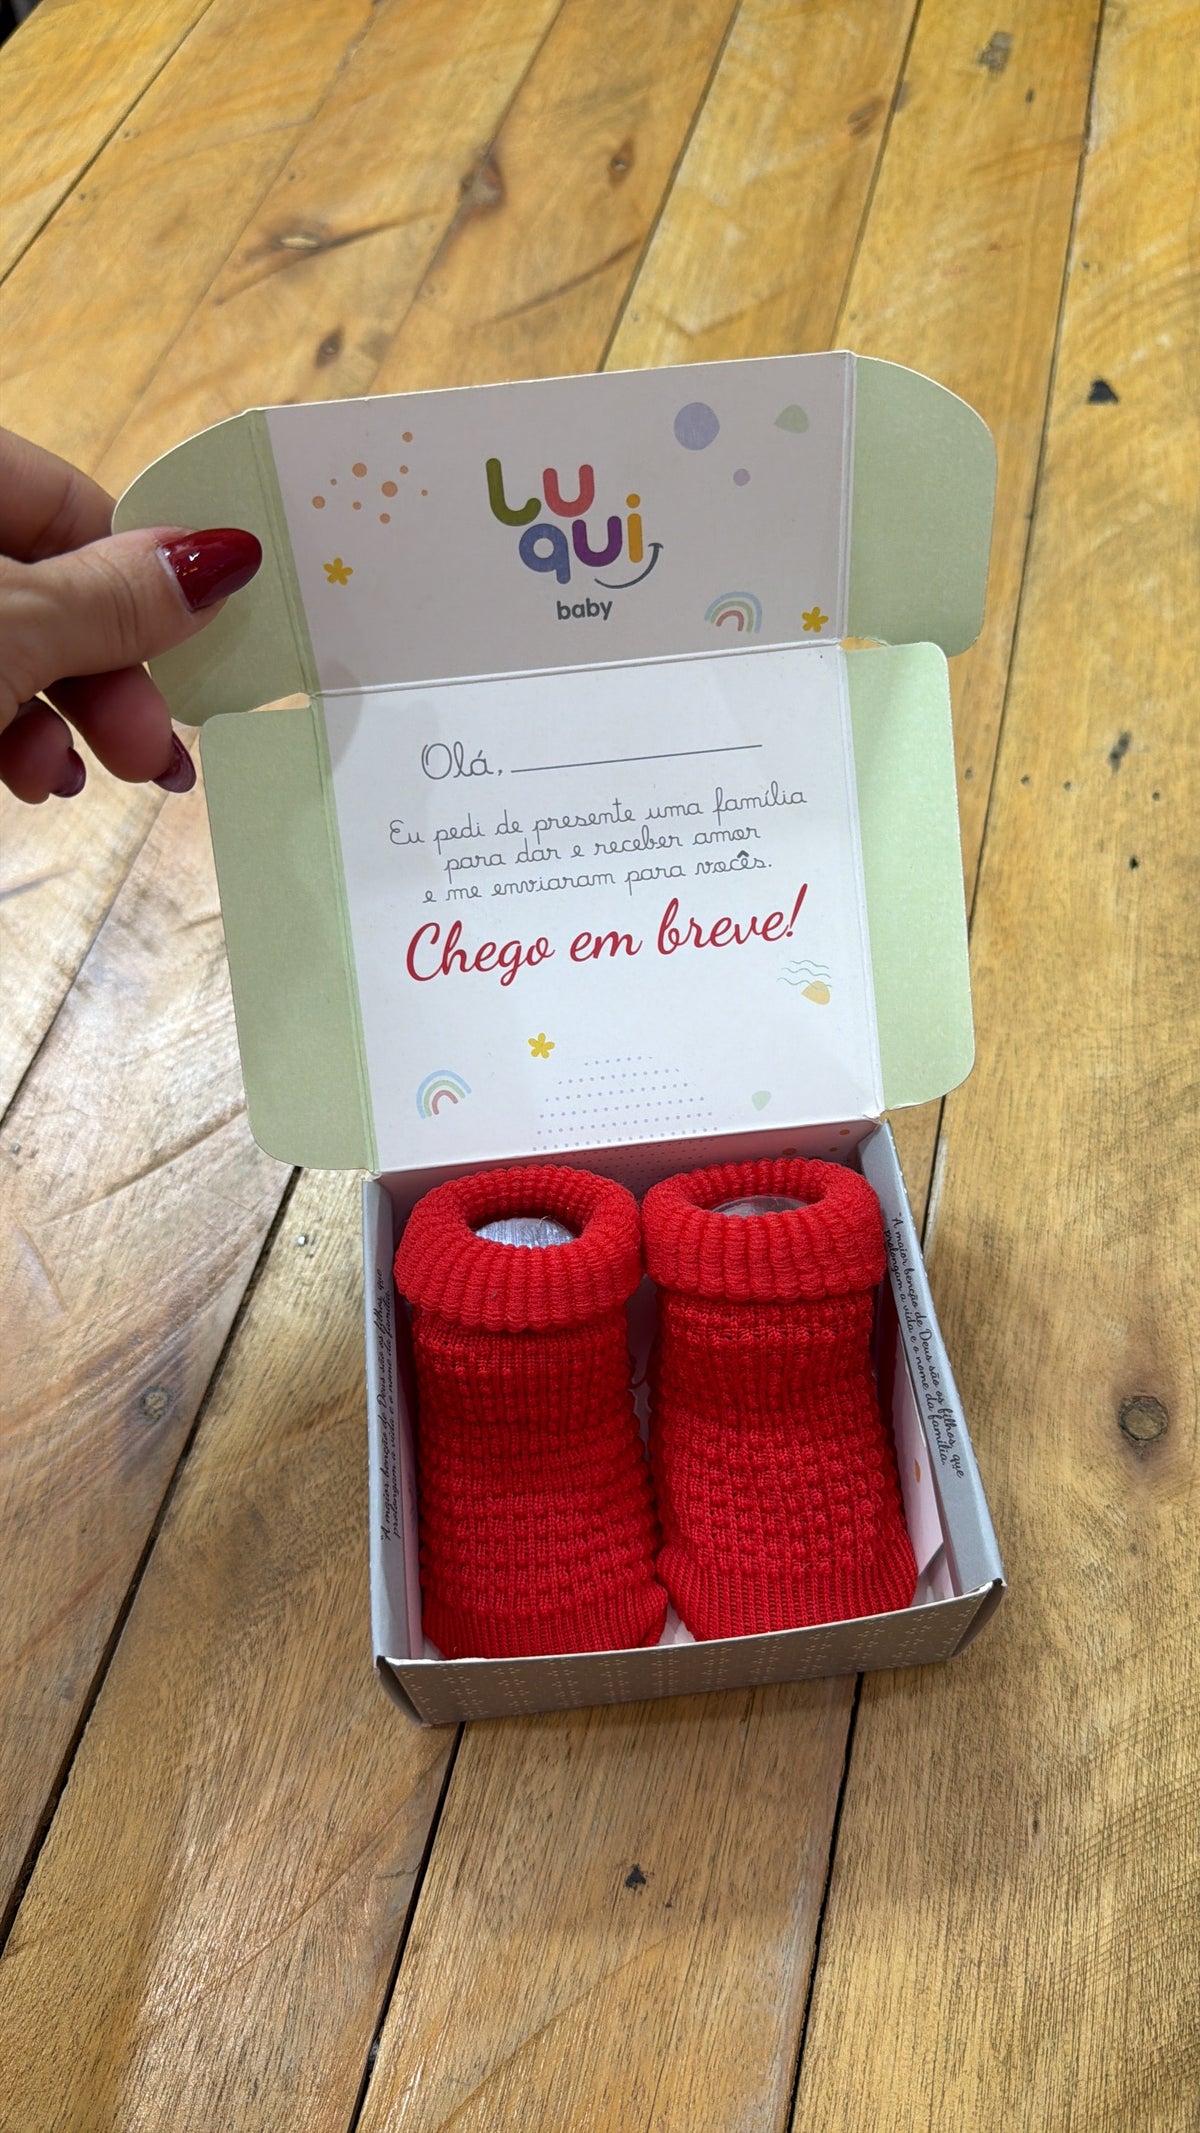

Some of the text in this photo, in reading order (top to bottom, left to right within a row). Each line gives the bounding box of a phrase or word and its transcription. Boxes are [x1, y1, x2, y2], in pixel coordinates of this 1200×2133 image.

[556, 598, 613, 621] baby
[421, 741, 503, 779] Olá,
[390, 780, 808, 855] Eu pedi de presente uma família
[444, 825, 761, 884] para dar e receber amor
[422, 850, 773, 904] e me enviaram para vocês.
[406, 883, 808, 987] Chego em breve!
[895, 1231, 908, 1267] maior
[903, 1267, 919, 1308] benção
[884, 1230, 903, 1290] prolongam
[903, 1305, 916, 1333] vida
[915, 1356, 929, 1391] nome
[925, 1392, 941, 1412] da
[915, 1311, 927, 1328] de
[919, 1328, 933, 1365] Deus
[929, 1364, 940, 1388] são
[936, 1390, 945, 1406] os
[950, 1454, 965, 1479] que
